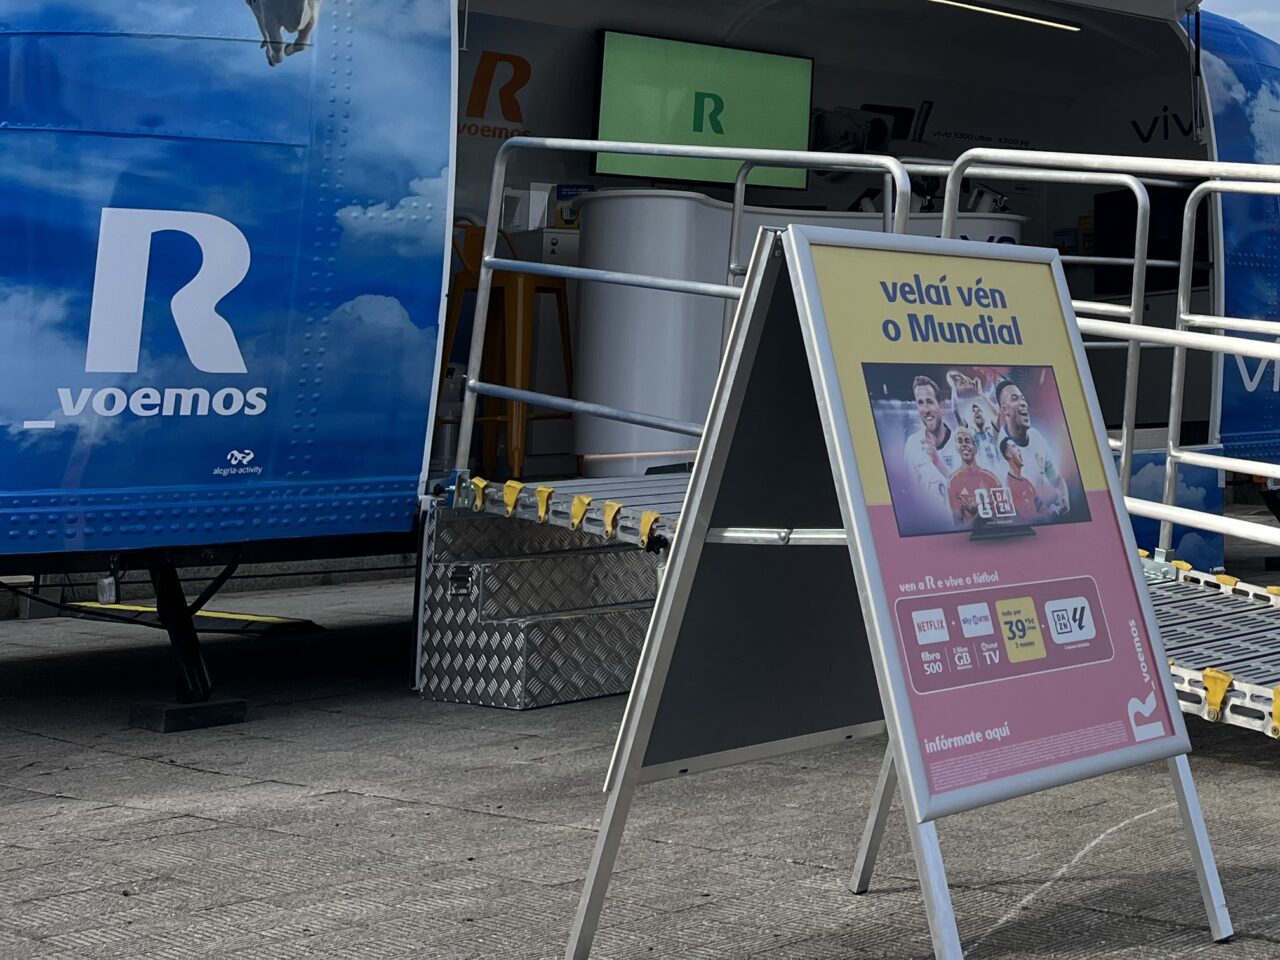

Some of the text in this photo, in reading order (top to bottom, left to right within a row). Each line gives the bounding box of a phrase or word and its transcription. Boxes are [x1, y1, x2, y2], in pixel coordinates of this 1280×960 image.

[466, 50, 531, 123] R
[692, 91, 725, 135] R
[1131, 105, 1205, 143] viv
[85, 207, 251, 374] R
[879, 273, 1008, 309] velaí vén
[881, 313, 1024, 346] o Mundial
[899, 582, 917, 592] ven
[925, 575, 936, 590] R
[937, 580, 943, 588] e
[944, 576, 964, 588] vive
[965, 577, 972, 585] o
[916, 618, 946, 633] NETFLIX
[923, 661, 943, 675] 500
[954, 653, 971, 666] GB
[982, 650, 1000, 665] TV
[1127, 691, 1165, 742] R
[924, 734, 983, 753] infórmate
[985, 721, 1011, 742] aquí
